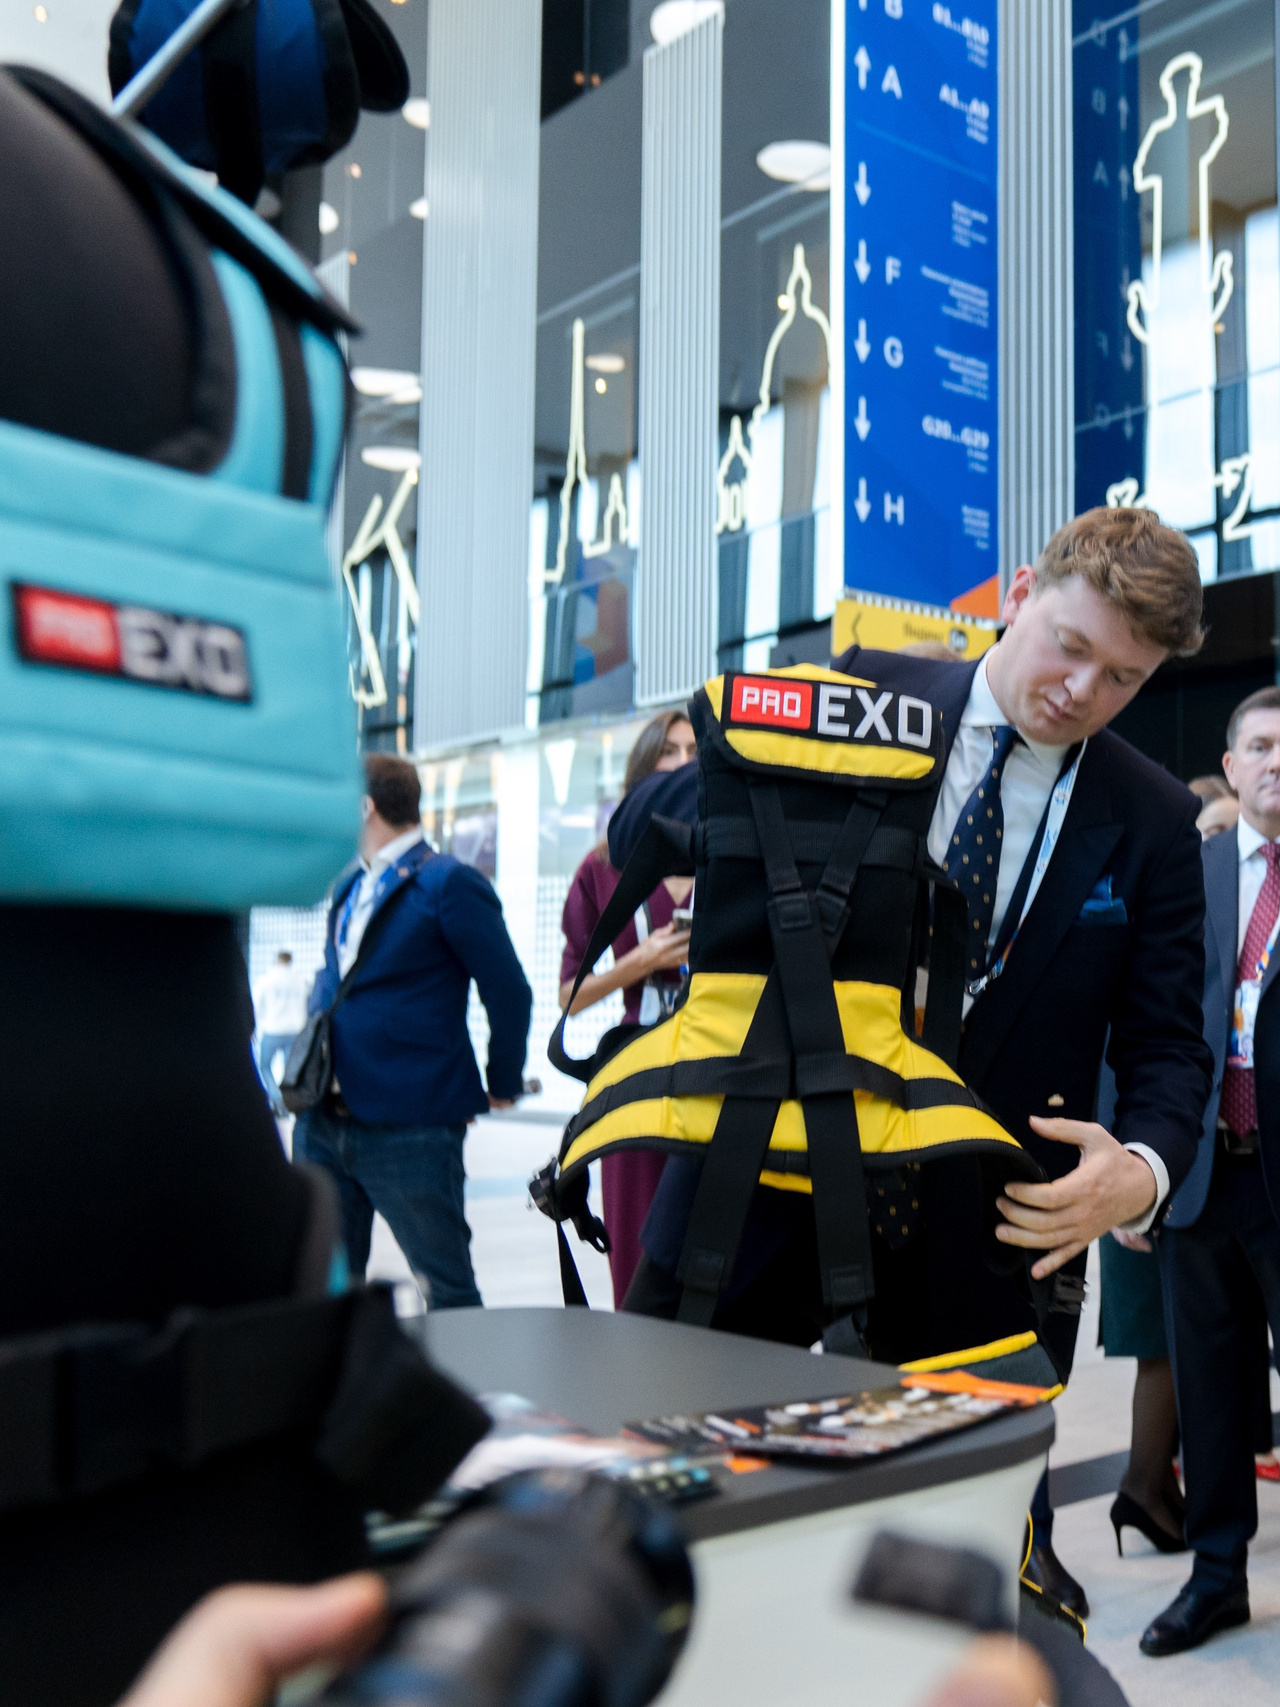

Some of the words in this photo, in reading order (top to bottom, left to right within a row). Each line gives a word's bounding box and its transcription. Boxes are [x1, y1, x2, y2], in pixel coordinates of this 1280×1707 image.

[881, 65, 902, 100] A
[885, 256, 901, 286] F
[883, 336, 904, 369] G
[883, 491, 905, 526] H
[817, 683, 933, 749] EXO
